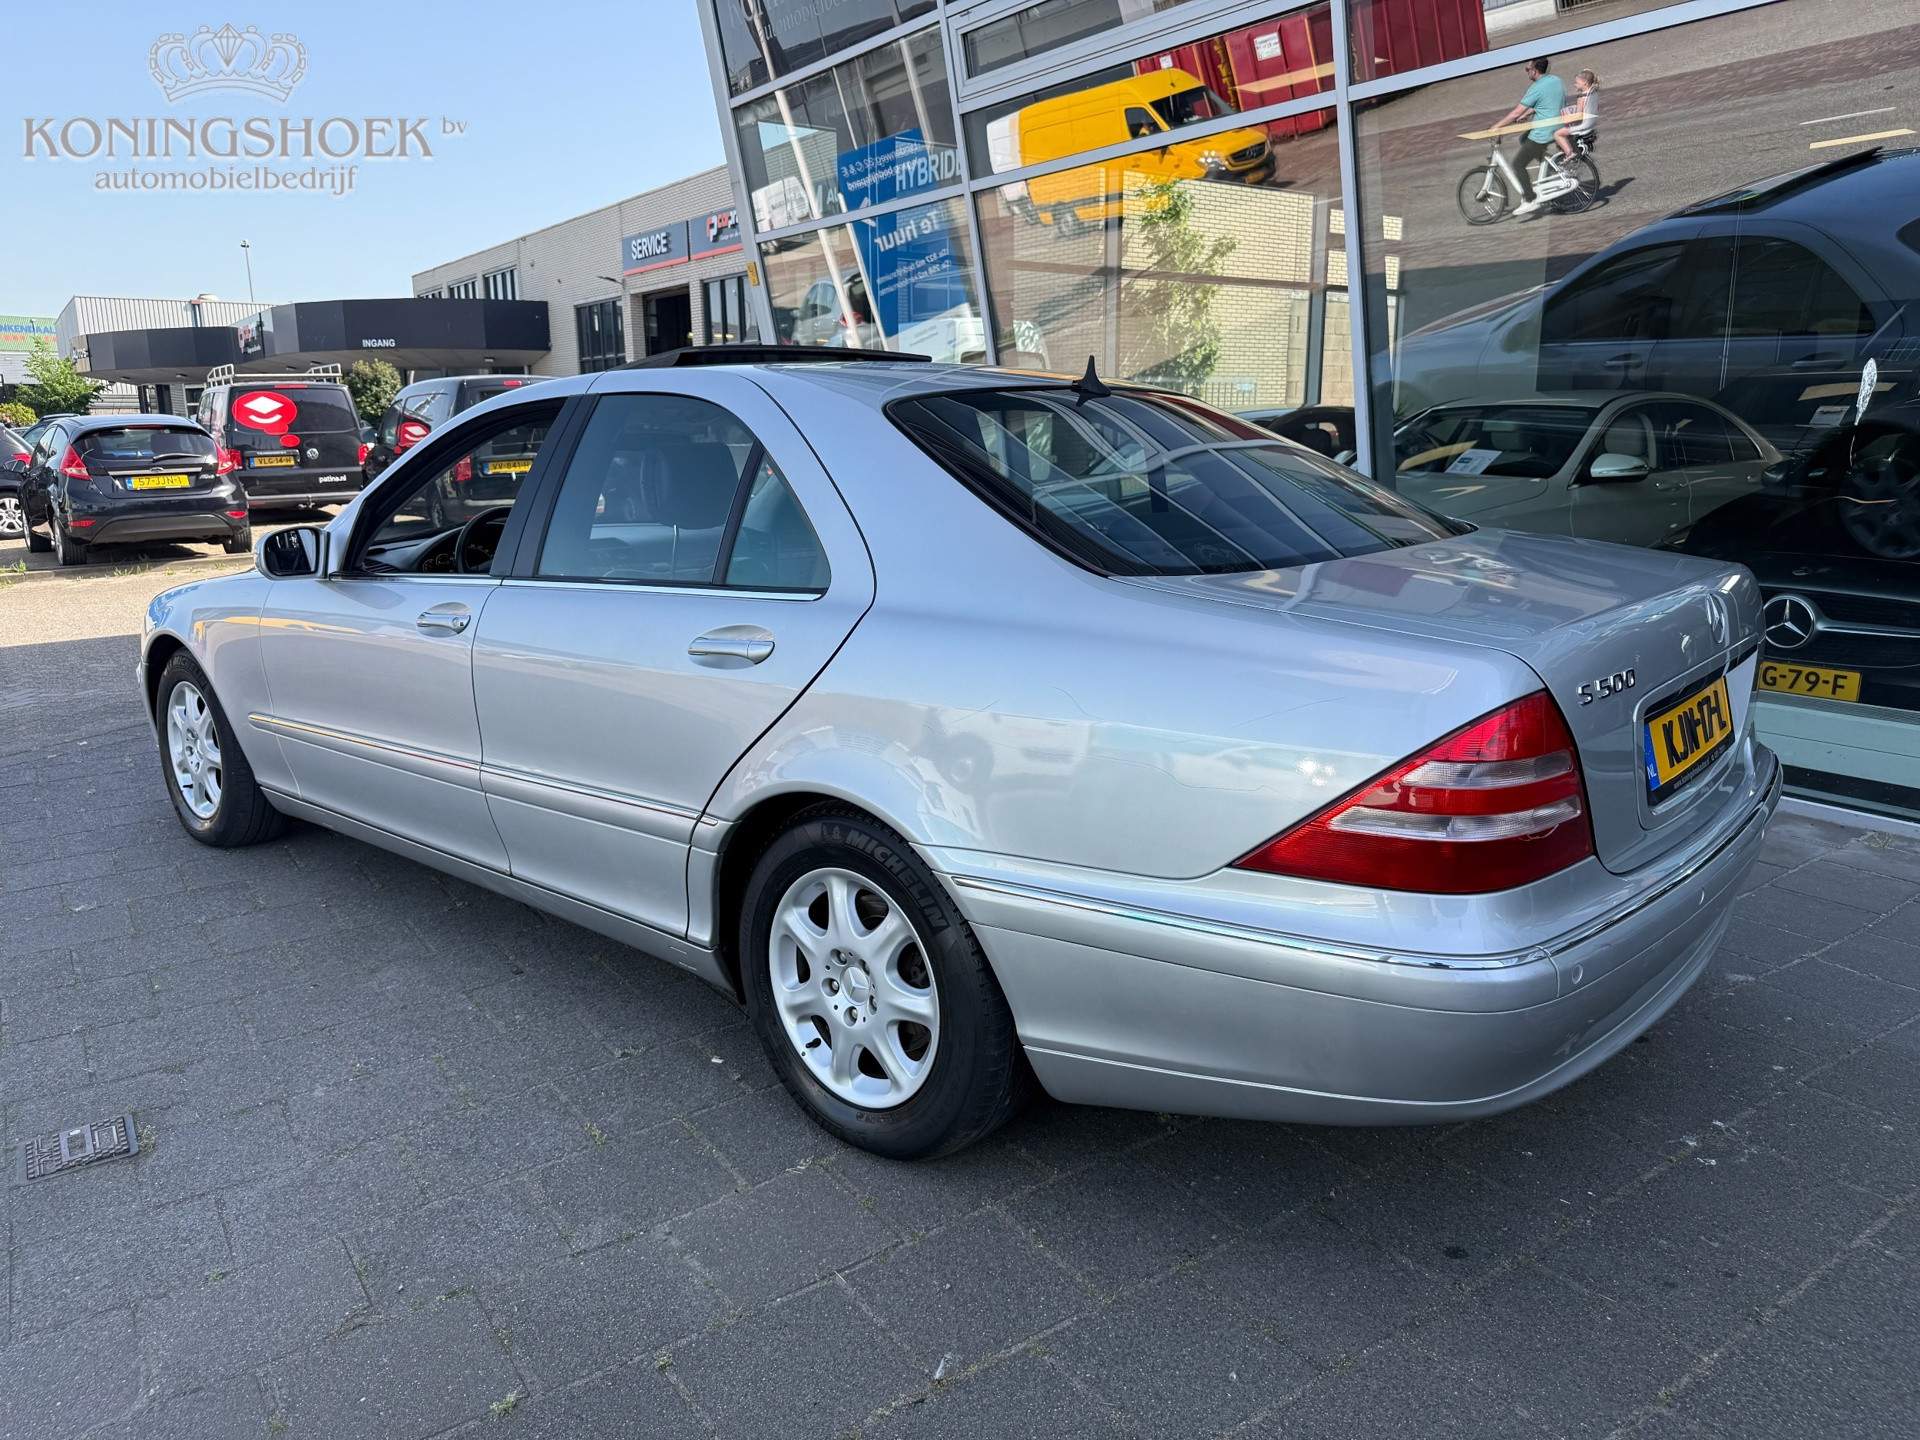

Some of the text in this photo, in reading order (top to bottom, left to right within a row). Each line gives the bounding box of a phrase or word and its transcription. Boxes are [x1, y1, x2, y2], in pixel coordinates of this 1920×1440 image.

[631, 232, 667, 260] SERVICE
[0, 323, 56, 335] NKENDAAL
[362, 338, 396, 348] INGANG
[138, 474, 182, 486] 57-JJN-1
[318, 475, 347, 483] patina.nl
[1576, 667, 1636, 707] S 500
[1761, 665, 1848, 696] G-79-F
[1662, 690, 1727, 769] KJN-17-L
[1646, 763, 1657, 780] NL
[844, 829, 951, 929] MICHELIN
